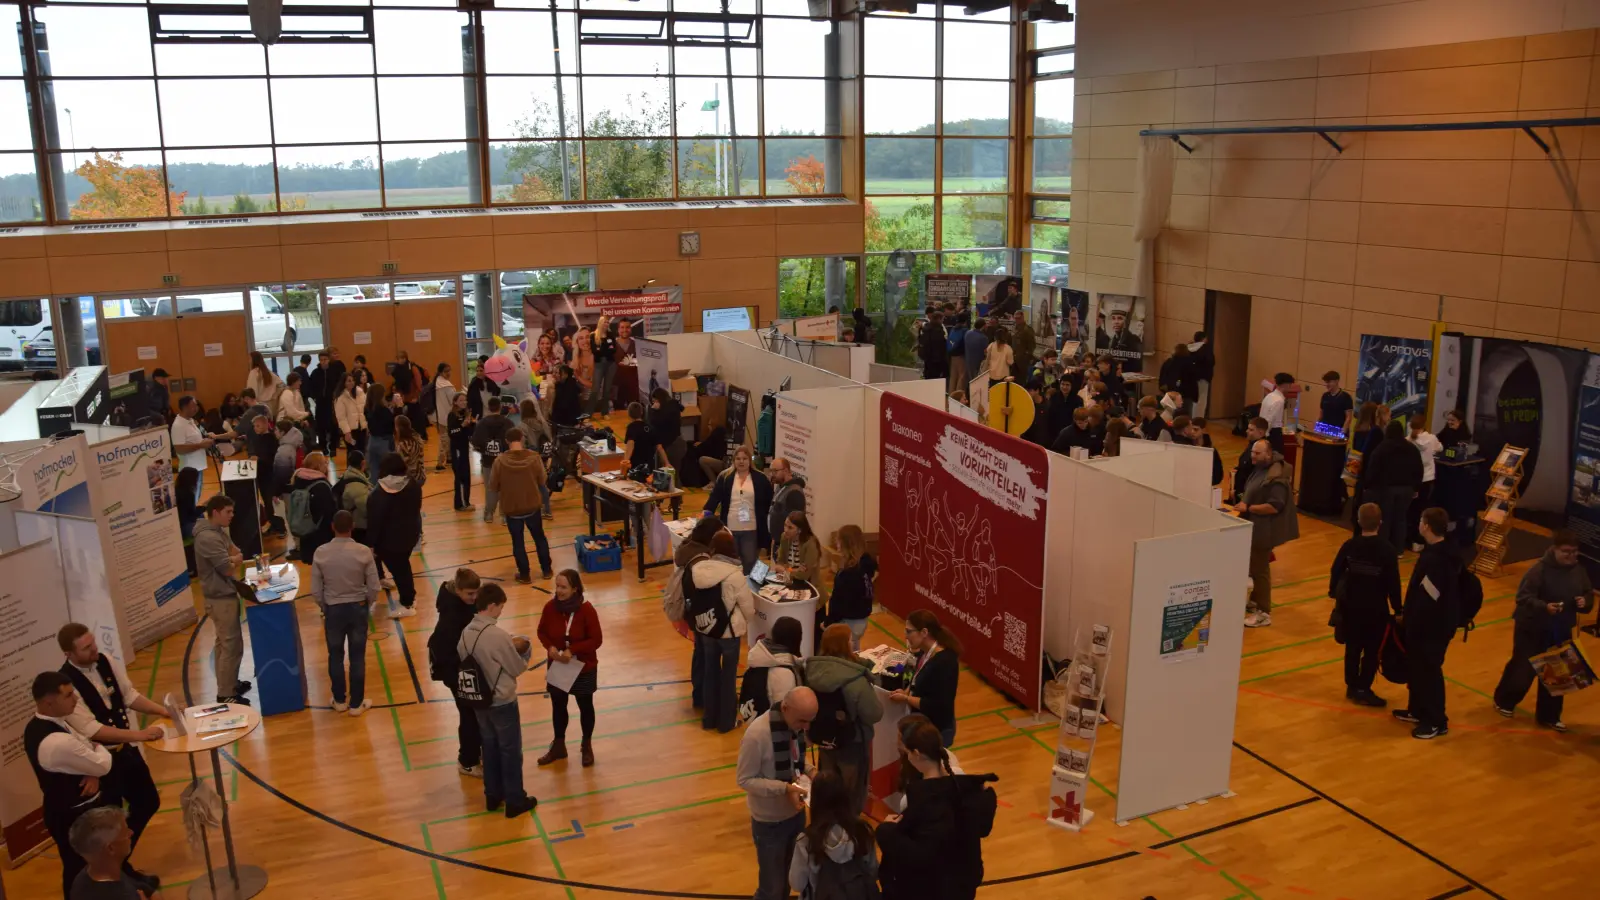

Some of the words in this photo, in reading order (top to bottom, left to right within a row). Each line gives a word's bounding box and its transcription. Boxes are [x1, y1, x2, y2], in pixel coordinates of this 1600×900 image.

[586, 297, 609, 305] Werde
[609, 294, 666, 304] Verwaltungsprofi
[602, 308, 614, 316] bei
[614, 307, 641, 315] unseren
[641, 305, 680, 314] Kommunen
[97, 435, 163, 465] hofmockel
[884, 442, 932, 468] www.keine-vorurteile.de
[950, 431, 969, 450] KEINE
[969, 442, 992, 462] MACHT
[993, 455, 1008, 472] DEN
[33, 450, 76, 481] hofmockel
[959, 451, 1026, 503] VORURTEILEN
[1184, 584, 1211, 595] contact
[694, 608, 716, 628] NIKE
[914, 581, 992, 639] www.keine-vorurteile.de
[994, 667, 1009, 684] Leben
